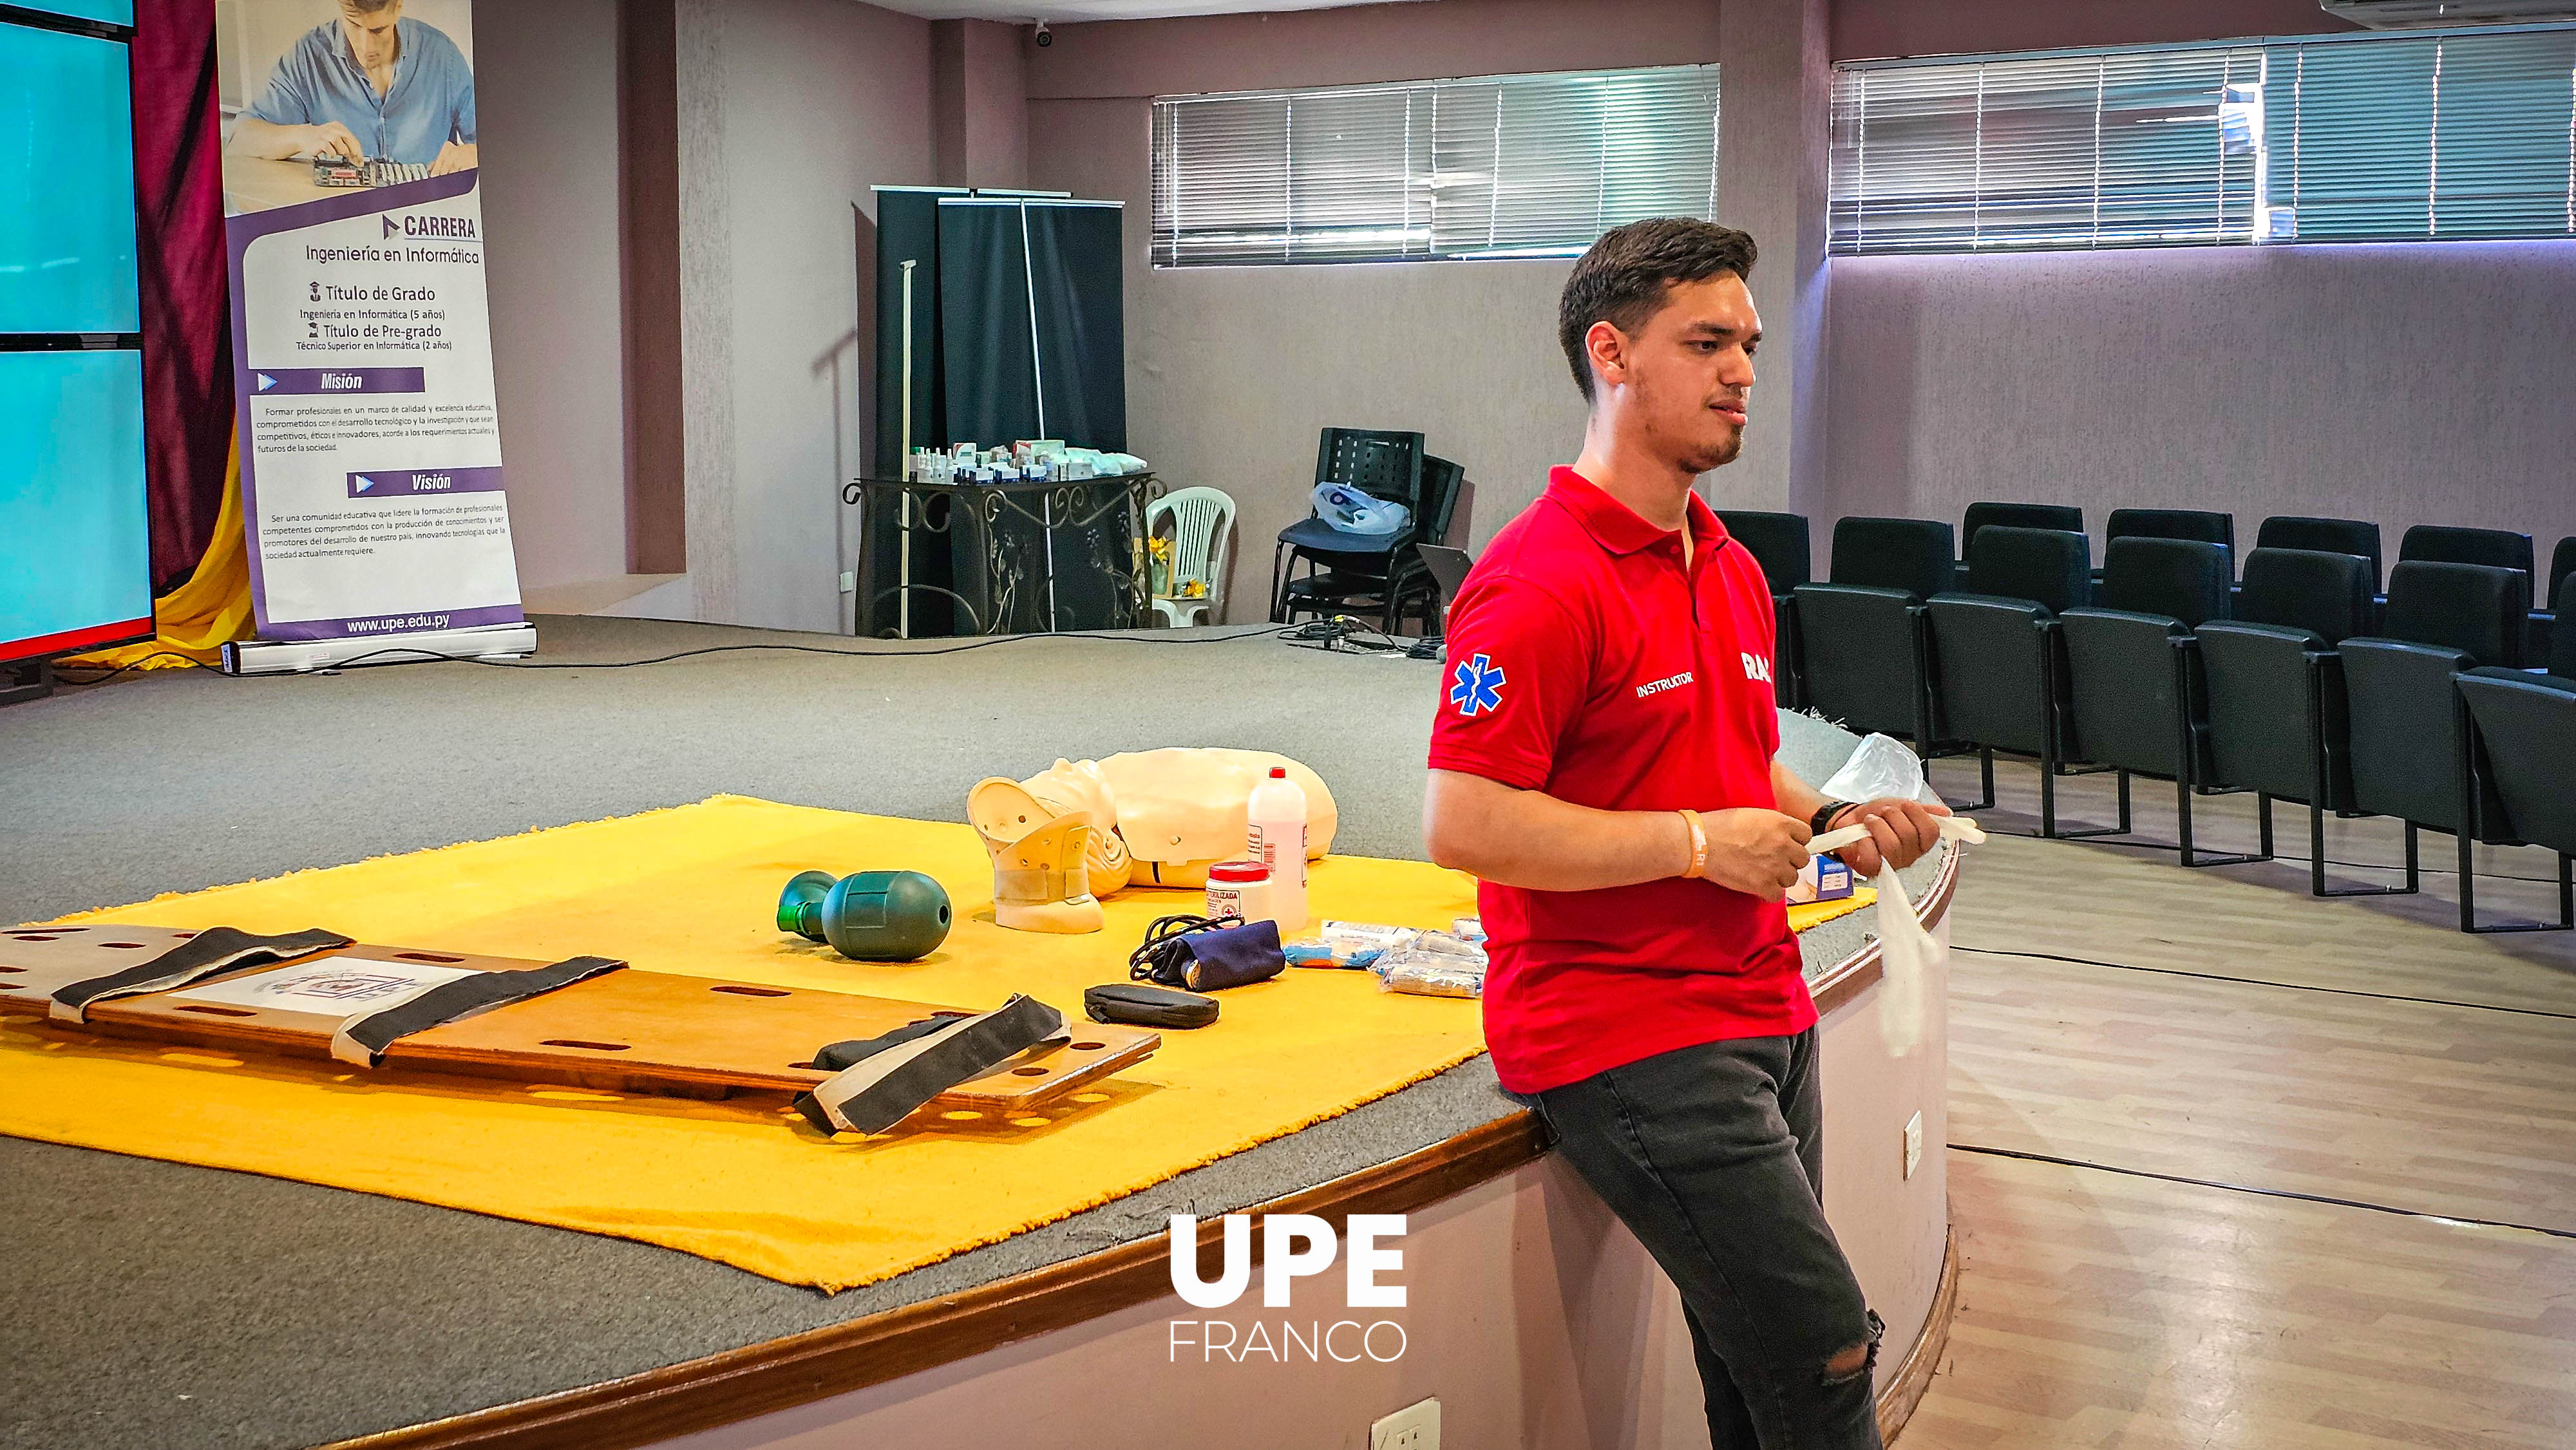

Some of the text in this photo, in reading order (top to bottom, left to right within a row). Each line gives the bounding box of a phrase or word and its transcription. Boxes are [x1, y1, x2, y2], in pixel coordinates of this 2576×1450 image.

[404, 215, 476, 238] CARRERA
[306, 245, 479, 264] Ingeniería en Informática
[326, 285, 435, 301] Título de Grado
[359, 309, 408, 319] Informática
[410, 309, 419, 321] (5
[422, 309, 445, 321] años)
[323, 325, 442, 341] Título de Pre-grado
[296, 341, 327, 350] Técnico
[327, 342, 361, 352] Superior
[376, 341, 420, 350] Informática
[422, 341, 430, 351] (2
[433, 341, 452, 351] años)
[321, 373, 363, 390] Misión
[297, 407, 341, 417] profesionales
[257, 419, 317, 429] comprometidos
[337, 418, 373, 426] desarrollo
[375, 417, 412, 426] tecnológico
[257, 432, 309, 441] competitivos,
[336, 430, 381, 439] innovadores,
[383, 429, 404, 437] acorde
[422, 428, 468, 437] requerimientos
[412, 473, 451, 491] Visión
[302, 513, 342, 522] comunidad
[343, 511, 377, 520] educativa
[422, 507, 455, 515] formación
[464, 505, 502, 514] profesionales
[263, 527, 312, 536] competentes
[315, 523, 369, 534] comprometidos
[395, 520, 433, 529] producción
[264, 538, 308, 548] promotores
[324, 536, 357, 545] desarrollo
[371, 534, 397, 542] nuestro
[416, 531, 451, 539] innovando
[265, 551, 298, 560] sociedad
[298, 549, 344, 558] actualmente
[348, 614, 450, 632] www.upe.edu.py
[1636, 672, 1694, 697] INSTRUCTOR
